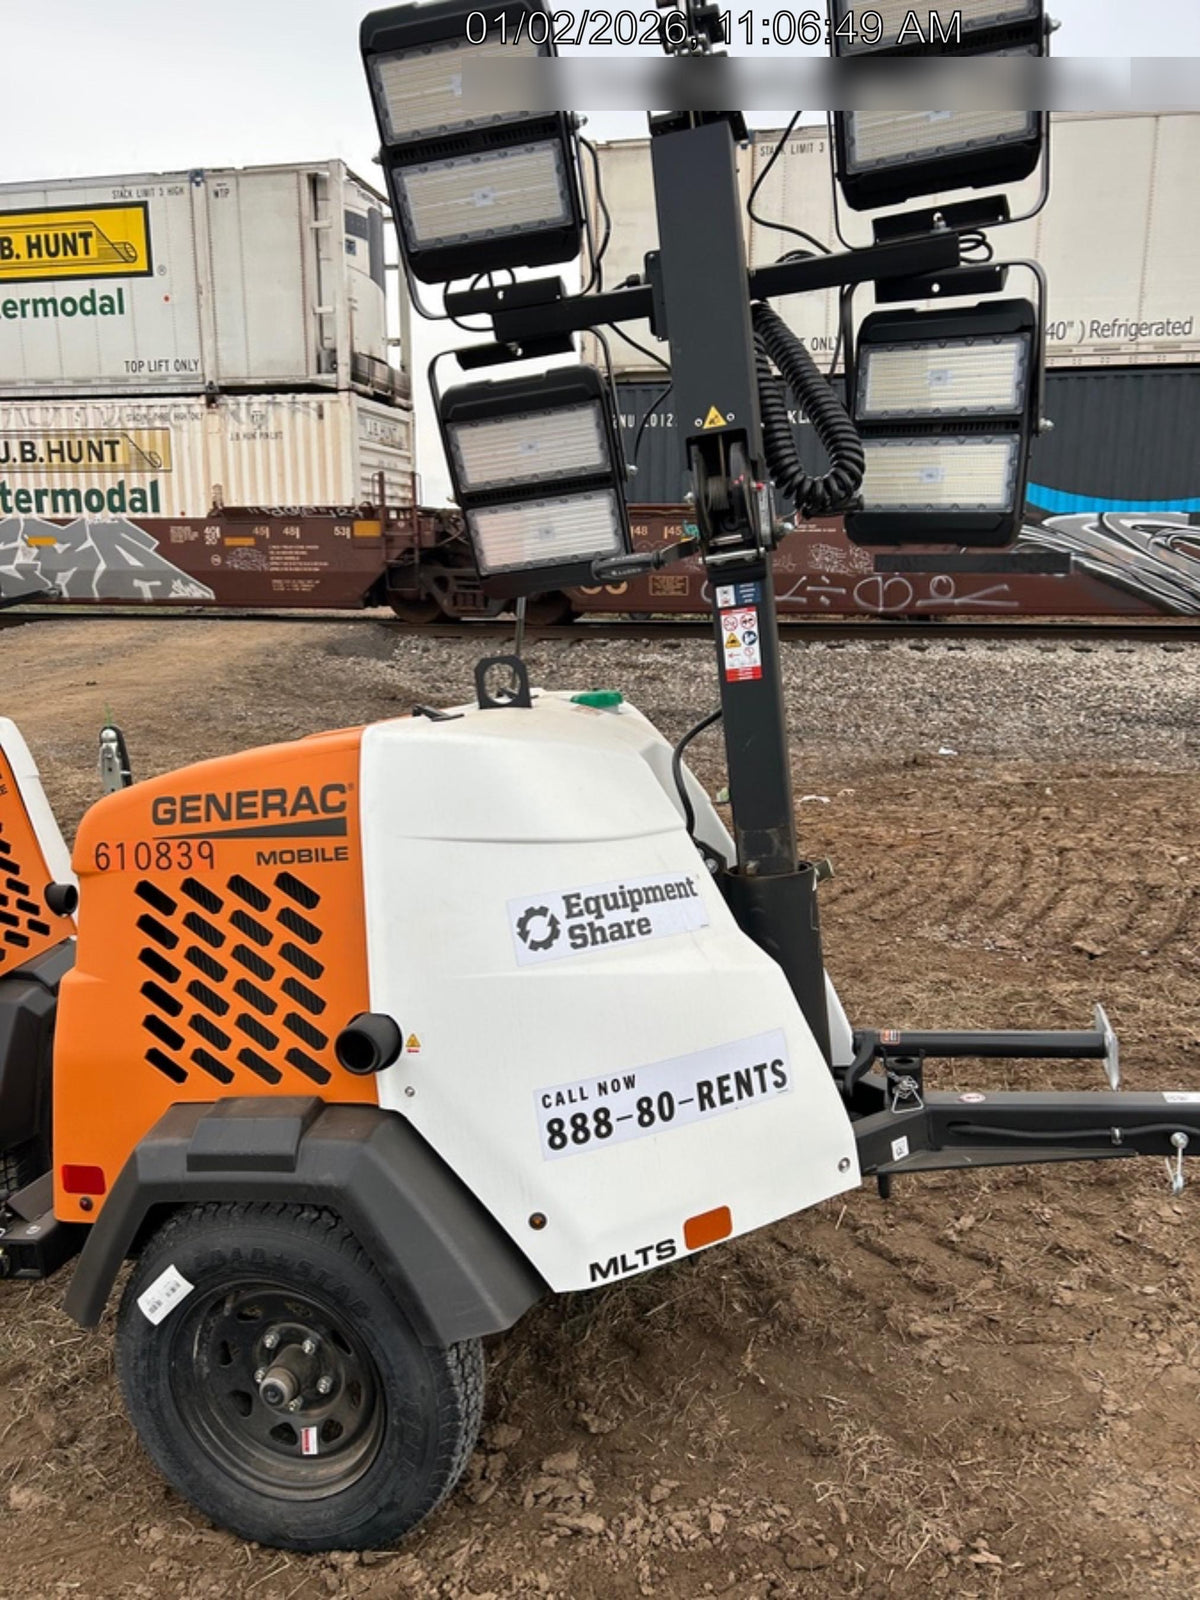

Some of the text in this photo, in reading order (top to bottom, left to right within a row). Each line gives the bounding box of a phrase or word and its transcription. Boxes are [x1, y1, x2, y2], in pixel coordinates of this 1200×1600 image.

[760, 145, 786, 157] STAK
[791, 142, 814, 155] LIMIT
[167, 186, 184, 196] HIGH
[26, 231, 94, 259] HUNT
[1089, 316, 1193, 342] Refrigerated
[125, 358, 200, 374] TOP LIFT ONLY
[152, 784, 348, 826] GENERAC
[95, 840, 215, 871] 610839
[256, 846, 348, 866] MOBILE
[562, 876, 698, 920] Equipment
[568, 916, 652, 949] Share
[541, 1074, 636, 1109] CALL NOW
[546, 1058, 787, 1151] 888-80-RENTS
[589, 1239, 677, 1282] MLTS
